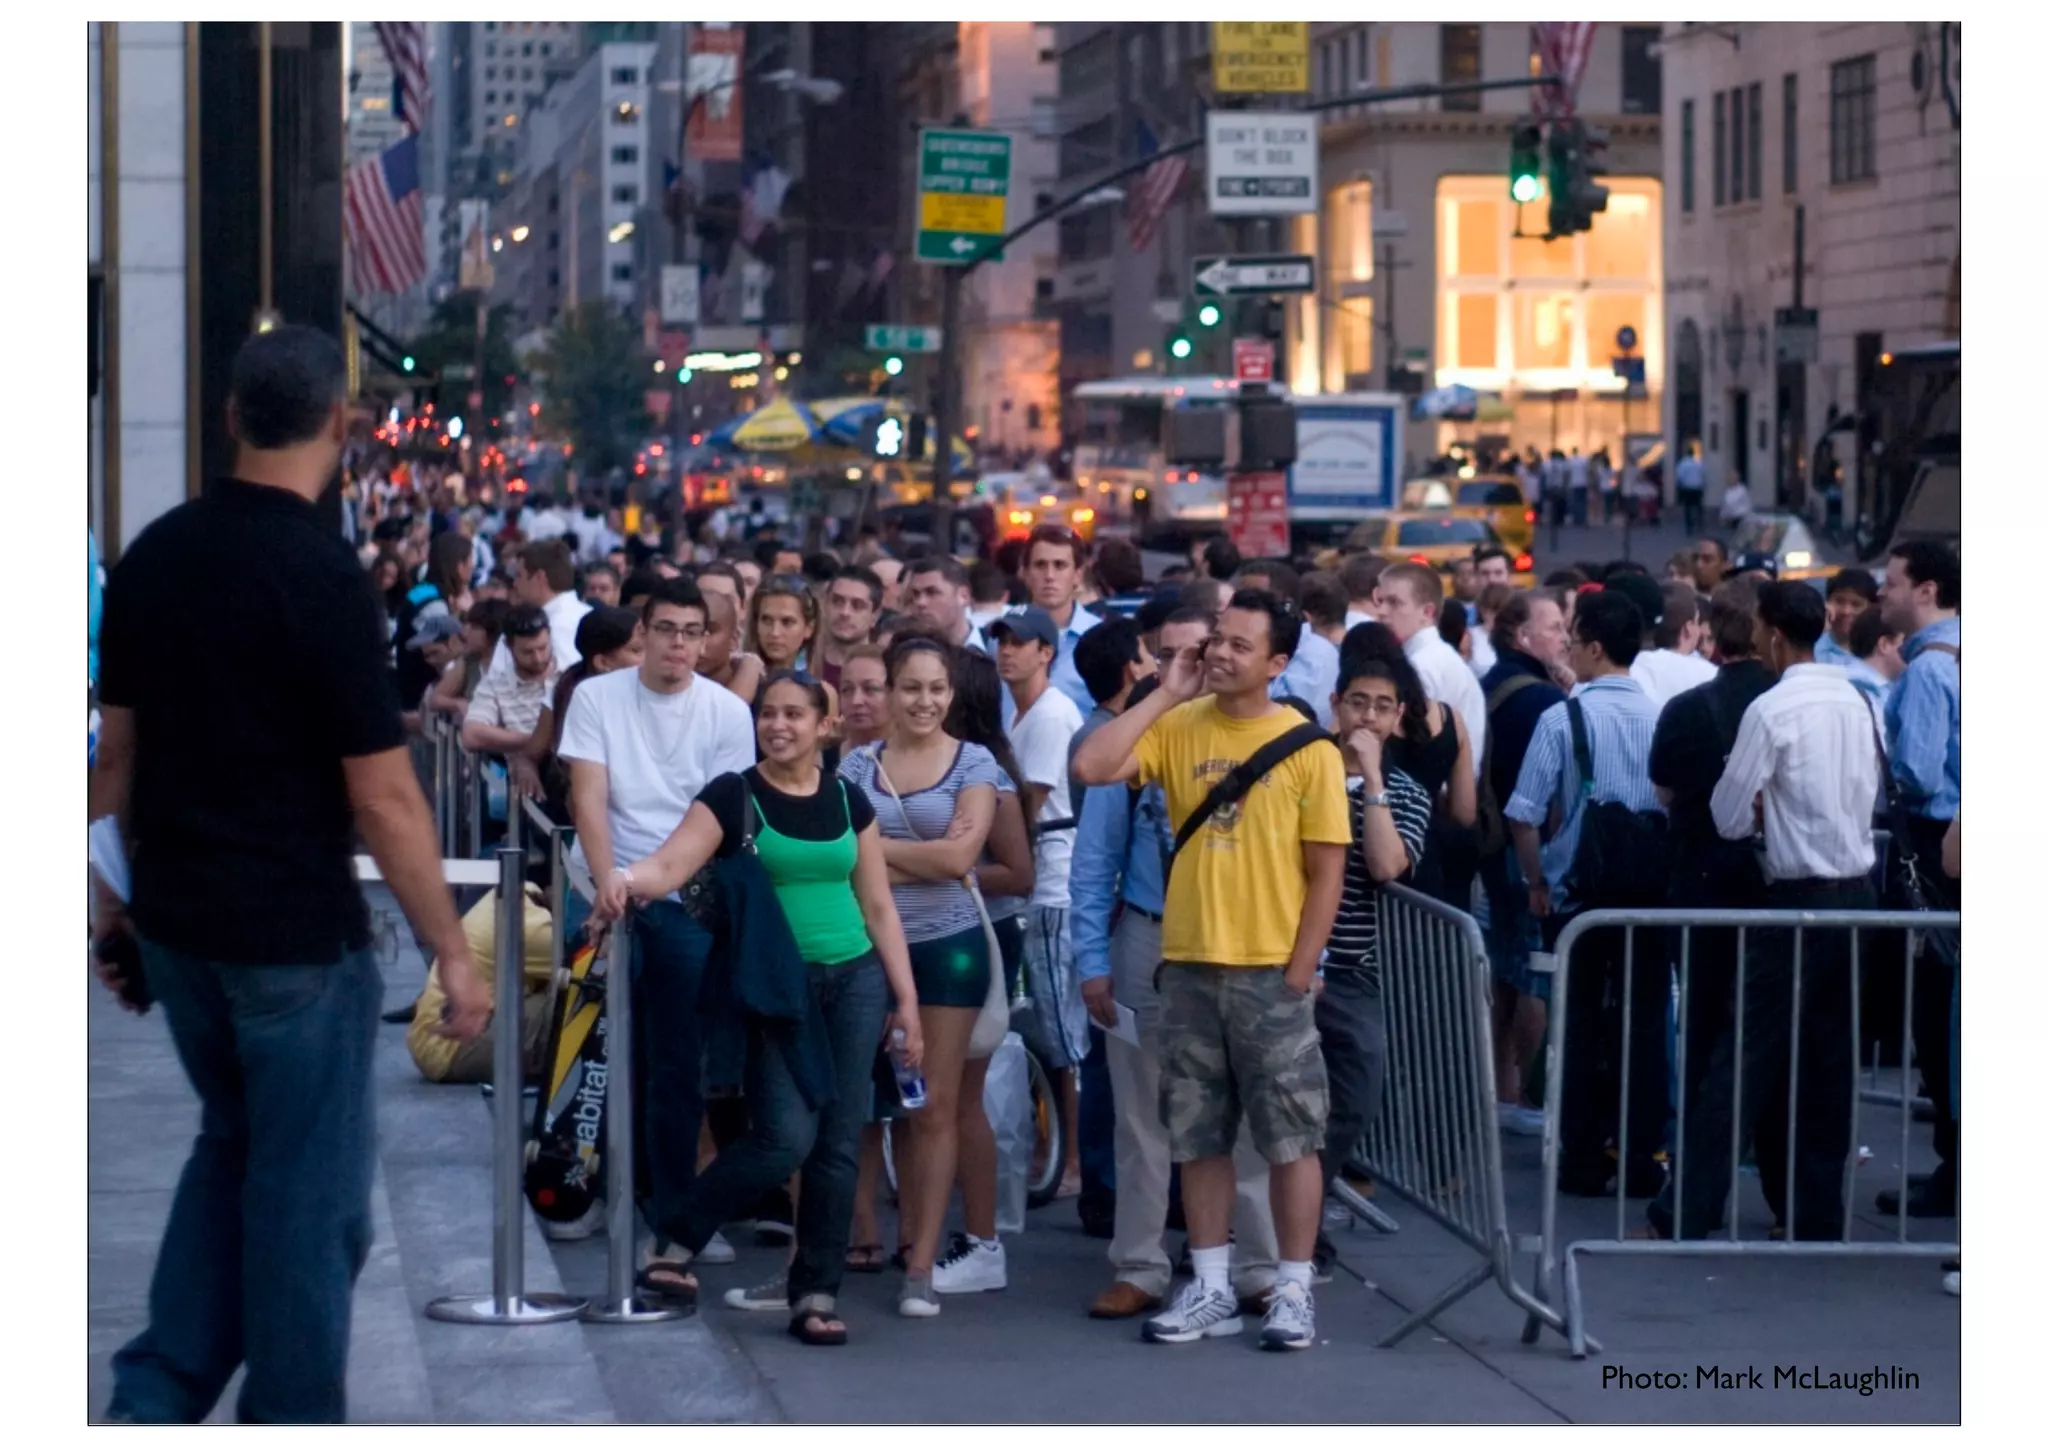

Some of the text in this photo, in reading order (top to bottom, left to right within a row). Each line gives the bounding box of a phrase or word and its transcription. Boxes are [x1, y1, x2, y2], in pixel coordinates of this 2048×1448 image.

[1217, 52, 1304, 67] EMERGENCY
[1228, 71, 1299, 87] VEHICLES
[1217, 128, 1308, 145] DON'T BLOCK
[1233, 148, 1294, 165] THE BOX
[941, 157, 989, 173] BRIDGE
[1209, 267, 1299, 284] ONE WAY
